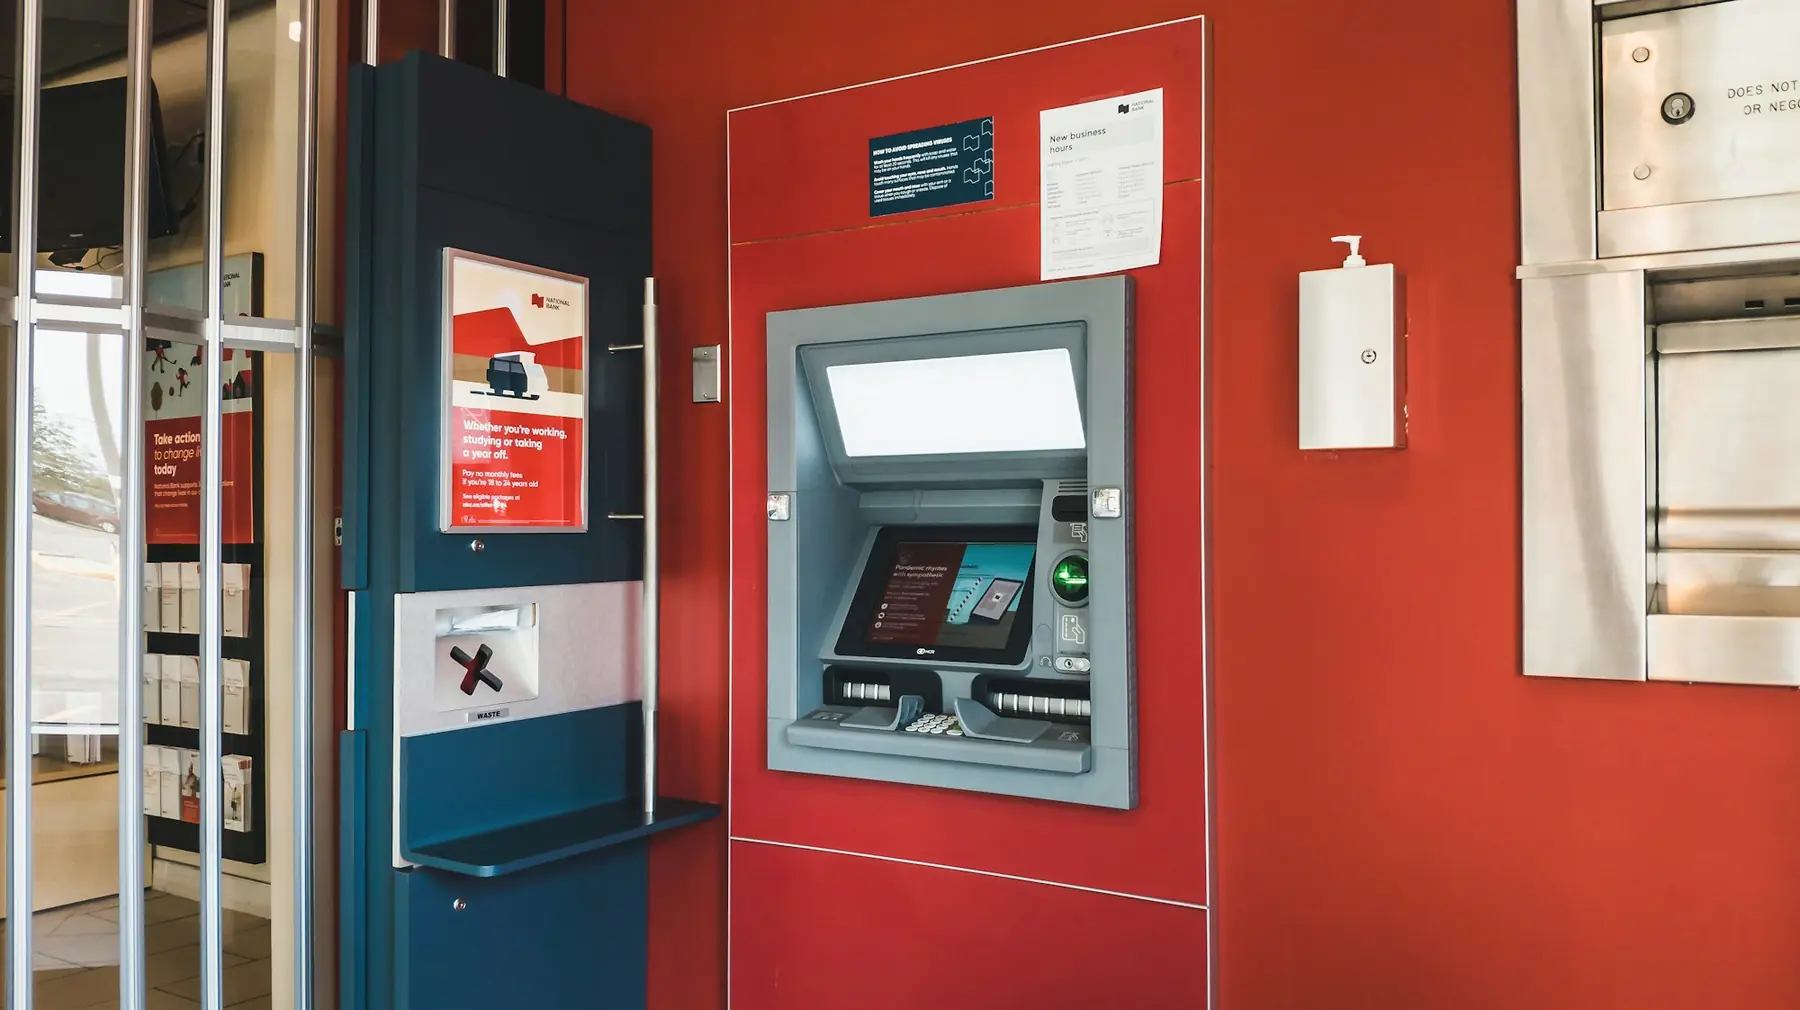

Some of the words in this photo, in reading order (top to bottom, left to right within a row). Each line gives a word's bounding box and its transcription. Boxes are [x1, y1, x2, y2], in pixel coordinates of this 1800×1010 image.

[1728, 84, 1763, 98] DOES
[1771, 80, 1798, 93] NOT
[1744, 104, 1761, 115] OR
[1050, 134, 1067, 143] New
[1070, 128, 1107, 140] business
[907, 141, 933, 150] SPREADING
[933, 137, 953, 146] VIRUSES
[1049, 144, 1072, 153] hours
[546, 297, 570, 306] NATIONAL
[463, 420, 502, 432] Whether
[504, 425, 530, 435] you're
[532, 428, 568, 439] working,
[154, 434, 173, 445] Take
[175, 431, 200, 443] action
[463, 435, 501, 447] studying
[514, 439, 542, 450] taking
[154, 451, 162, 460] to
[164, 447, 194, 461] change
[472, 450, 492, 460] year
[494, 450, 508, 459] off.
[154, 463, 176, 477] today
[462, 469, 474, 478] Pay
[485, 471, 509, 479] monthly
[477, 711, 500, 719] WASTE
